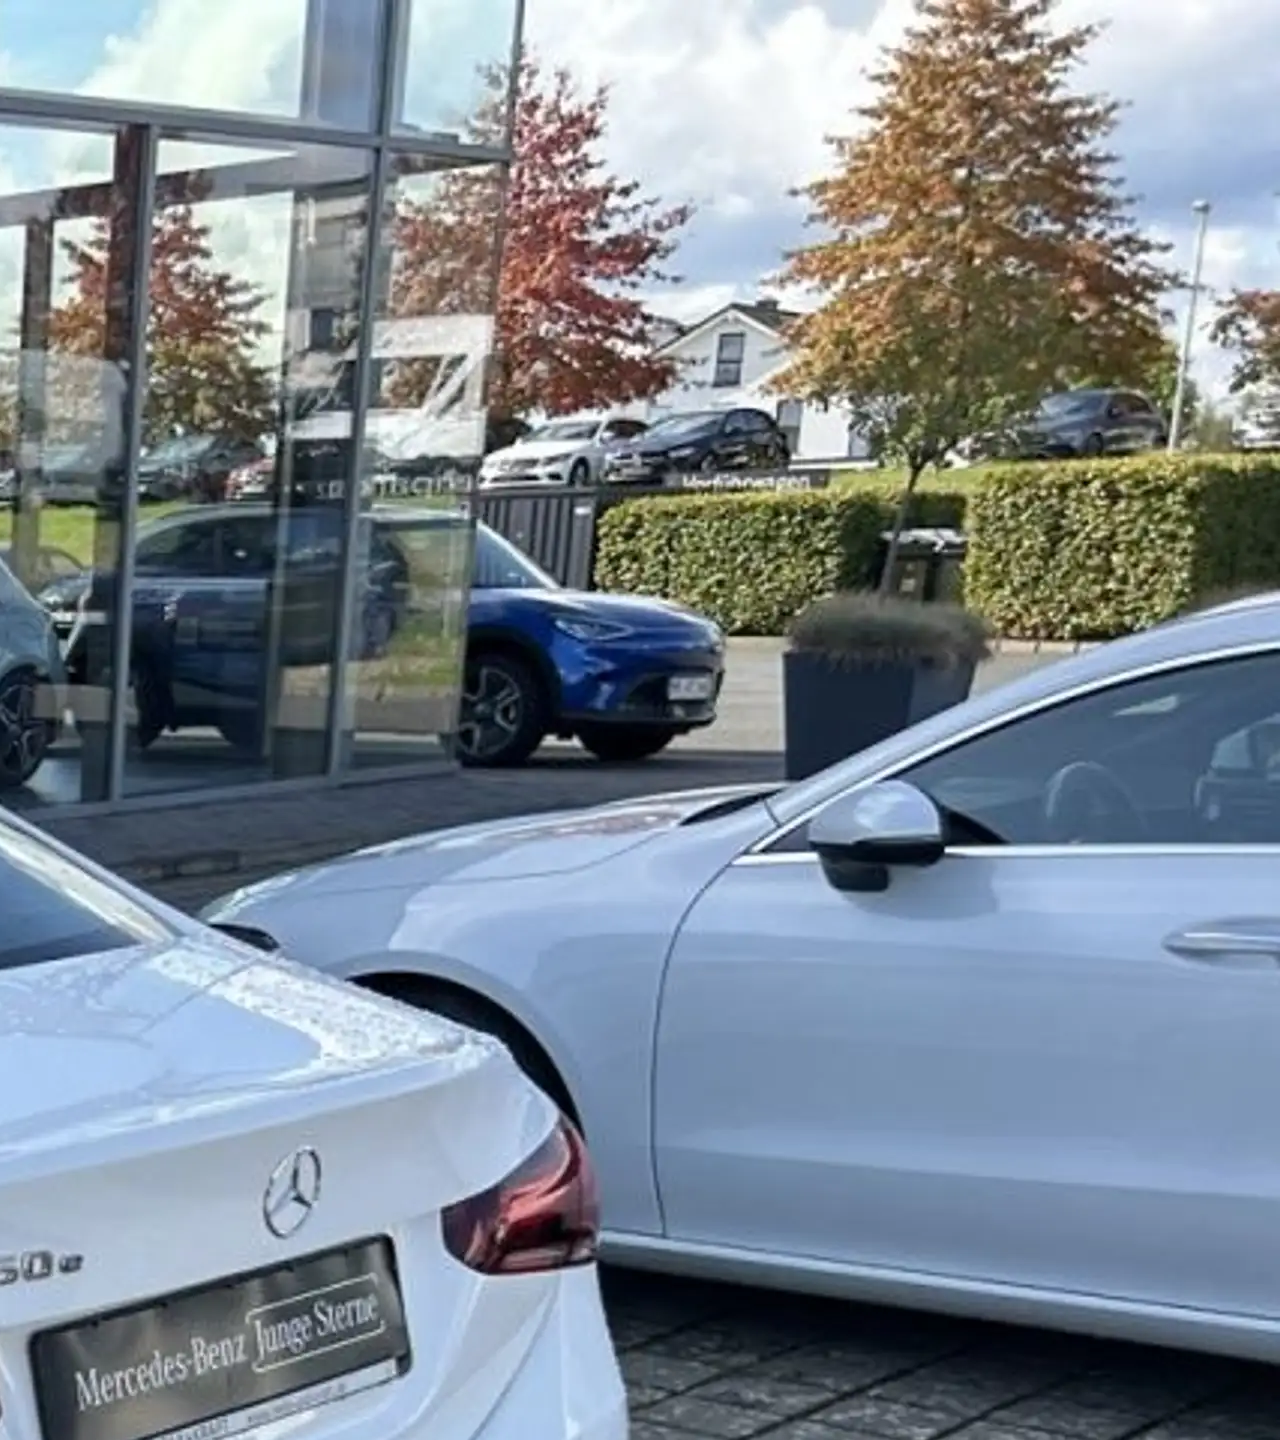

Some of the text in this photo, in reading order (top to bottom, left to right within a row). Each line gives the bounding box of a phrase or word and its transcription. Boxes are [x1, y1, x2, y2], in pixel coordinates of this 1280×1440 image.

[74, 1333, 247, 1412] Mercedes-Benz
[254, 1314, 312, 1361] Junge
[313, 1292, 378, 1338] Sterne
